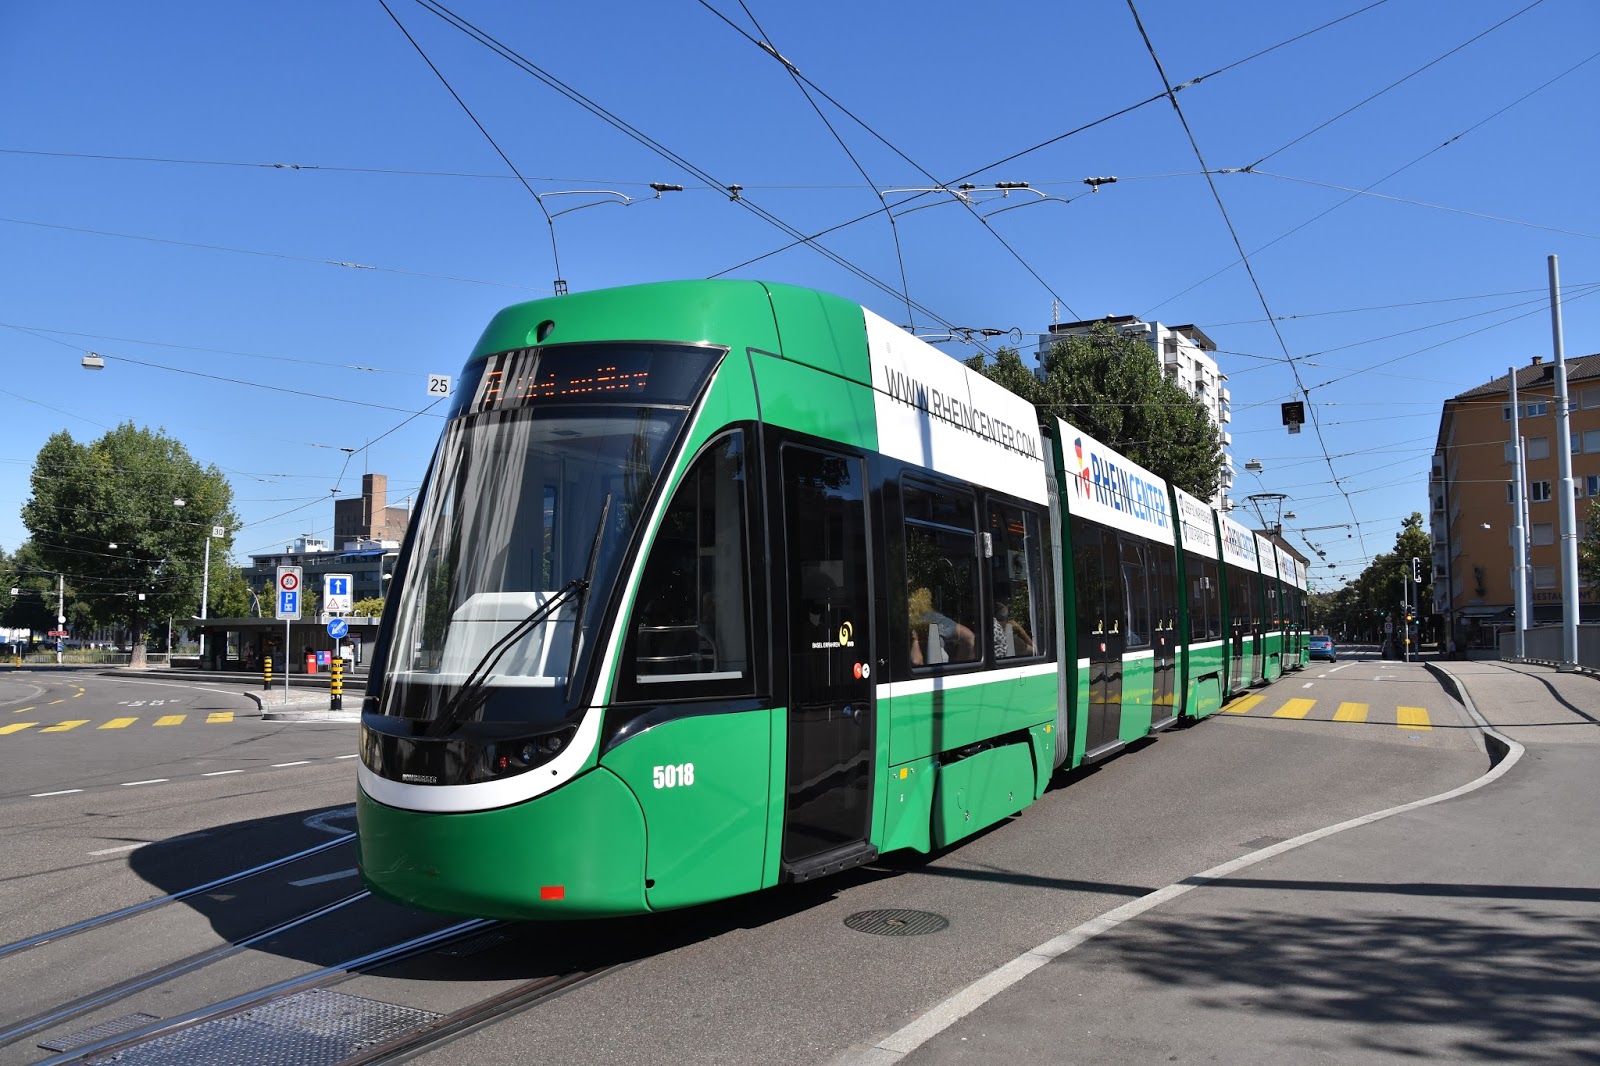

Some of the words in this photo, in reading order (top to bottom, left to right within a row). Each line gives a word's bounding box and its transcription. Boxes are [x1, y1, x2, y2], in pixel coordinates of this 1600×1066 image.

[430, 378, 449, 394] 25
[884, 365, 1038, 463] WWW.RHEINCENTER.COM
[1090, 452, 1169, 529] RHEINCENTER
[213, 528, 224, 536] 30
[284, 578, 294, 586] 30
[285, 592, 293, 604] P
[1533, 591, 1592, 601] RESTAUNT
[652, 762, 696, 790] 5018
